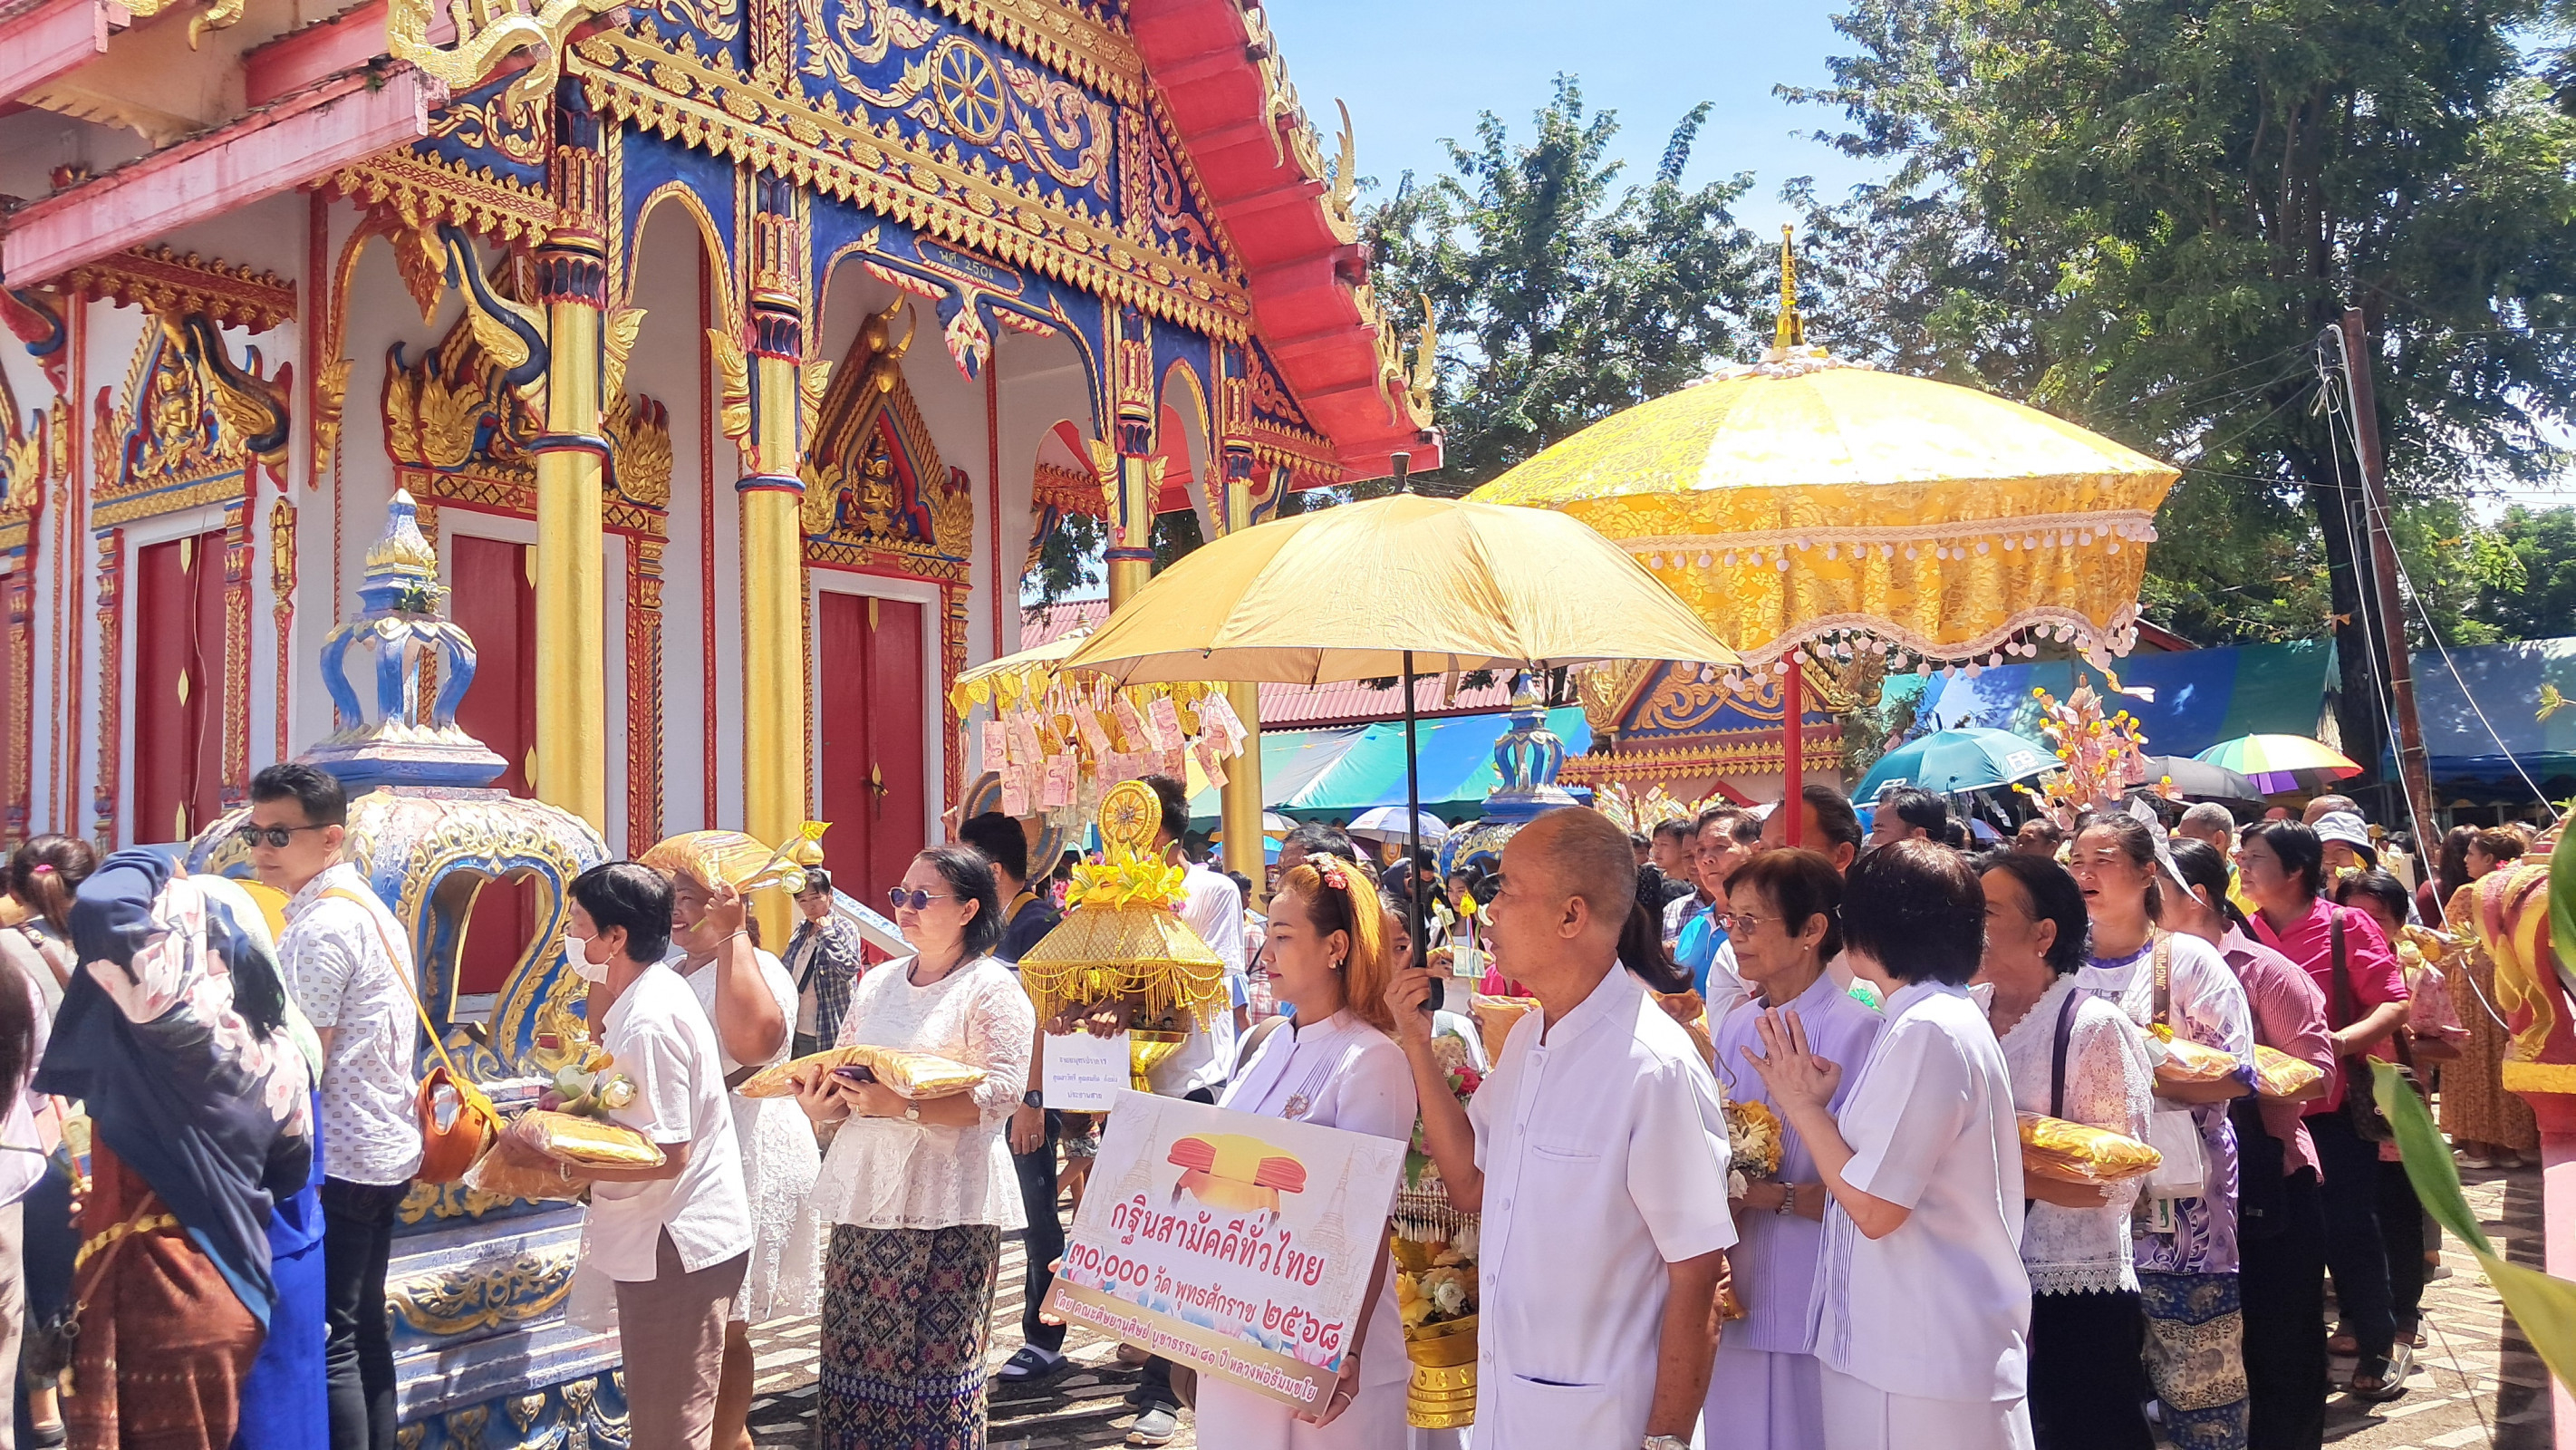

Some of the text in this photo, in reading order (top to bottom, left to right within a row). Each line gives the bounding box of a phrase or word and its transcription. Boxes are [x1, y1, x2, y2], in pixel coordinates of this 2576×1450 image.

[965, 259, 994, 279] 2506
[1111, 1194, 1325, 1286] กฐินสามัคคีทั่วไทย
[1069, 1243, 1343, 1350] ๓๐,๐๐๐ วัด พุทธศักราช ๒๕๖๘
[1015, 1352, 1032, 1363] ILA
[1055, 1290, 1317, 1400] โดย คณะศิษยานุศิษย์ บูชาธรรม ๘๑ ปี หลวงพ่อธัมมชโย
